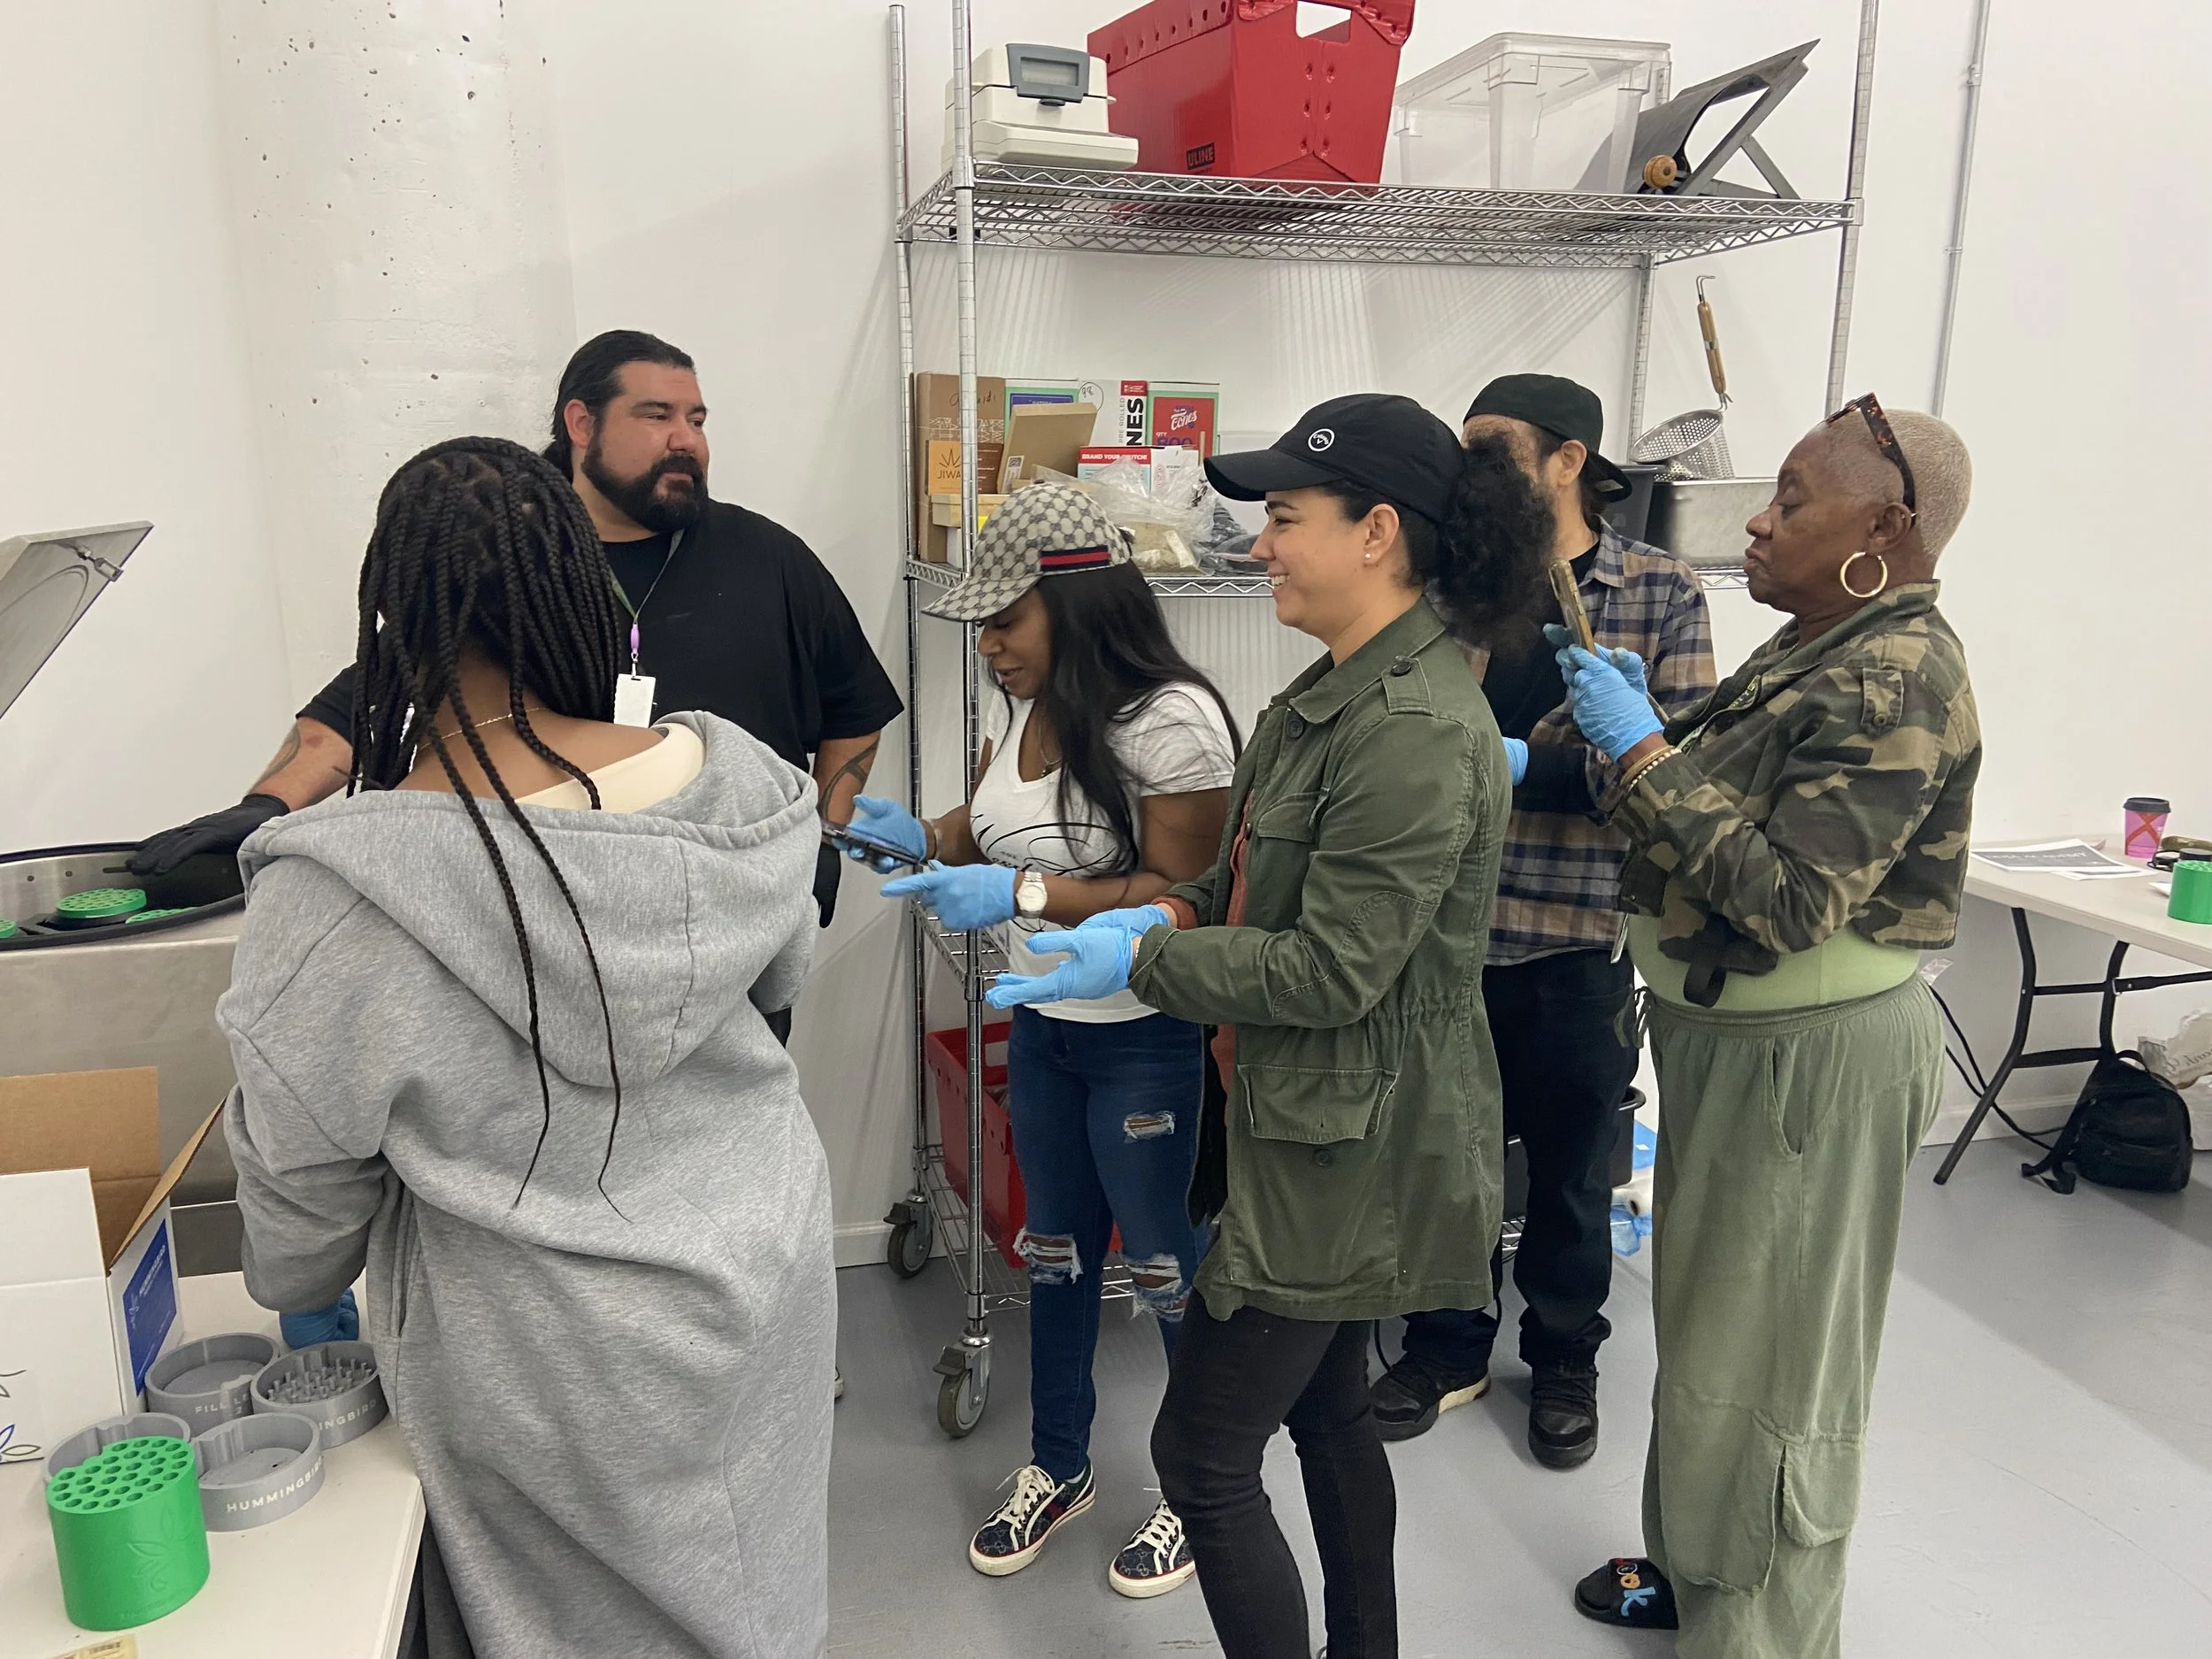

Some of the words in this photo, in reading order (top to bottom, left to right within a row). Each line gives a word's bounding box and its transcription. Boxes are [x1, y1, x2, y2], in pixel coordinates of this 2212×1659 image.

[1187, 146, 1214, 166] ULINE
[196, 1402, 227, 1414] FILL
[1616, 1559, 1656, 1617] ook
